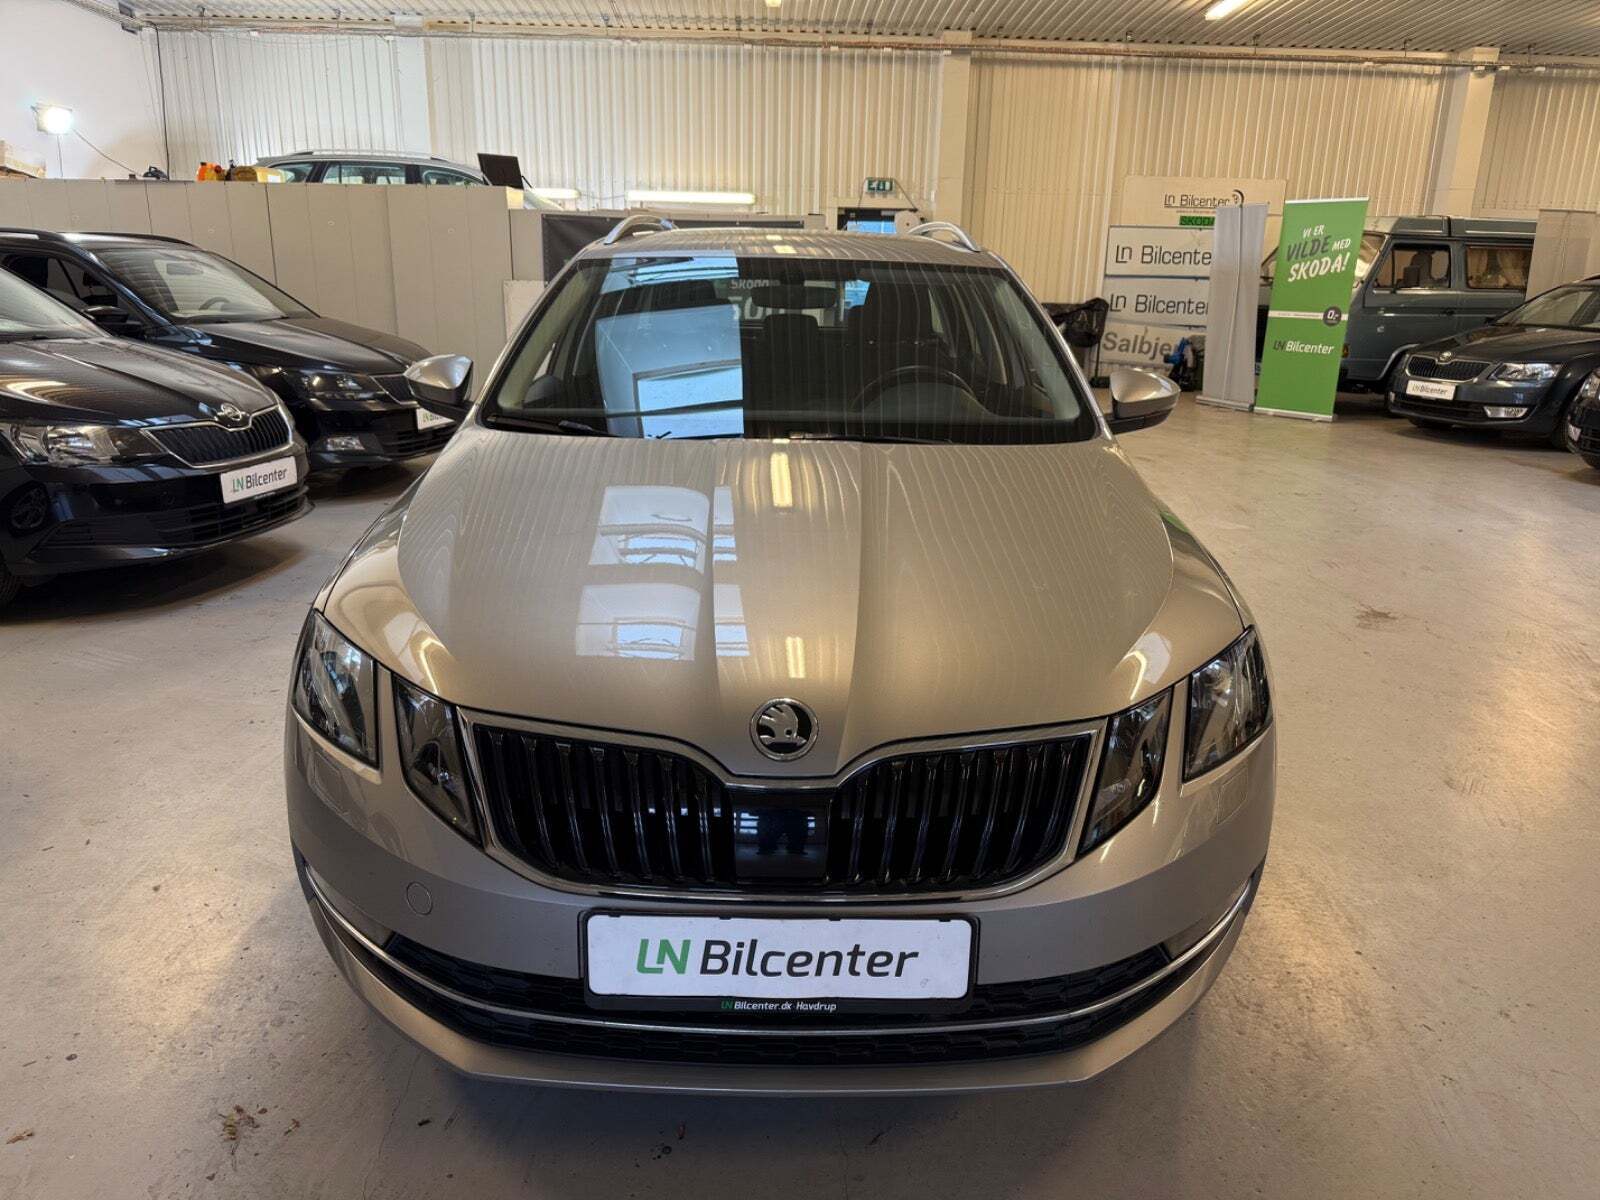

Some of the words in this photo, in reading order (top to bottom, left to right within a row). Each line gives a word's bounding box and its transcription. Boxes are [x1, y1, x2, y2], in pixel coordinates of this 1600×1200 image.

[1303, 228, 1312, 239] VI
[1313, 225, 1325, 236] ER
[1141, 245, 1212, 265] Bilcente
[1287, 236, 1332, 262] VILDE
[1332, 239, 1351, 252] MED
[1288, 252, 1350, 282] SKODA!
[245, 468, 287, 489] Bilcenter
[636, 938, 691, 975] LN
[699, 939, 919, 978] Bilcenter
[796, 1001, 837, 1012] Havdrup
